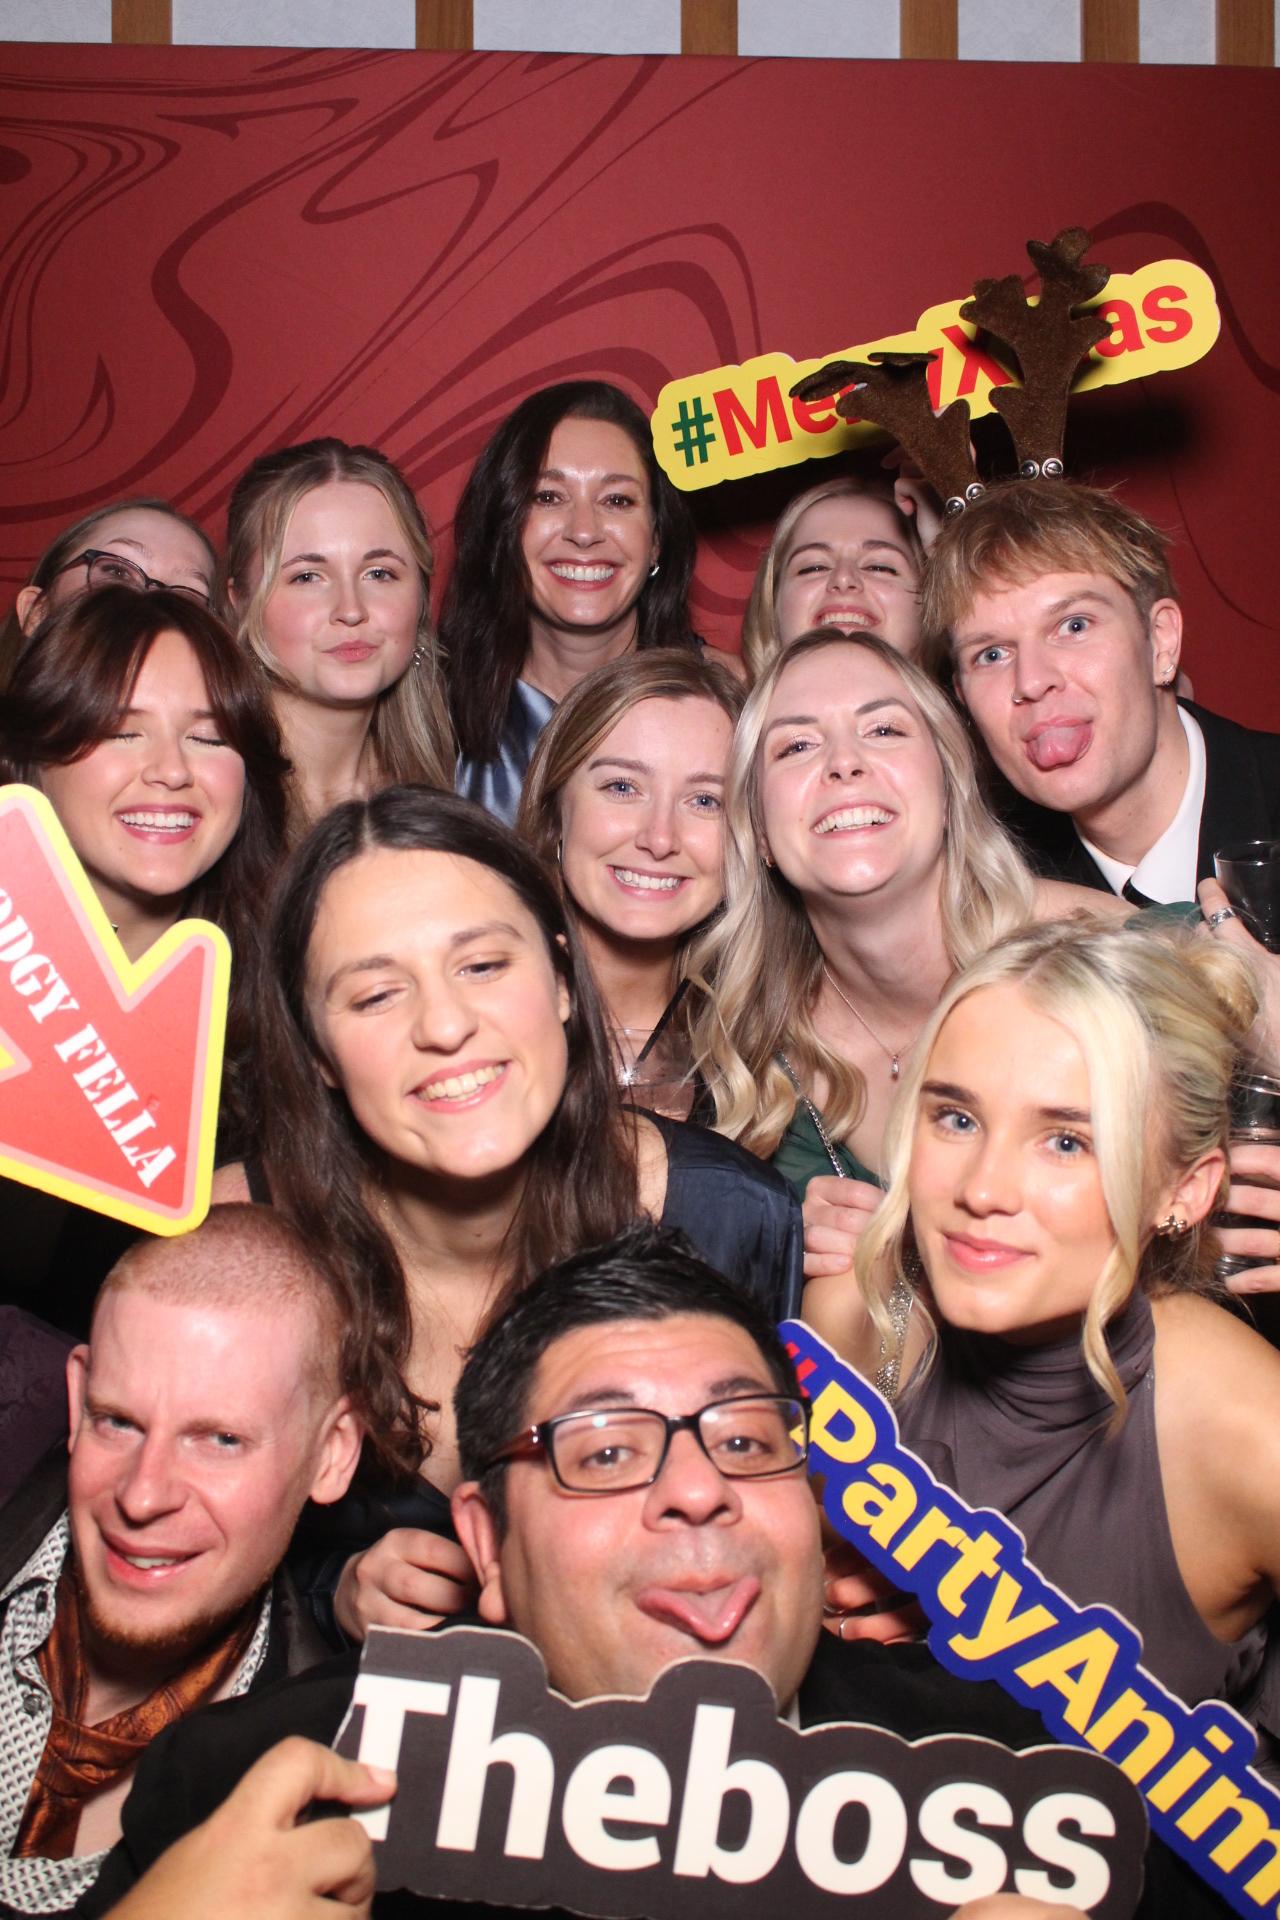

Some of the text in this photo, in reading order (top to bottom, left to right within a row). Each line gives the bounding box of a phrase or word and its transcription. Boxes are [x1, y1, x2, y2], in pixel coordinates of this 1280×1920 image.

[670, 285, 1194, 467] #MeXas
[0, 887, 177, 1189] DGY FELLA
[785, 1341, 1280, 1920] PartyAnim
[350, 1673, 1117, 1912] Theboss
